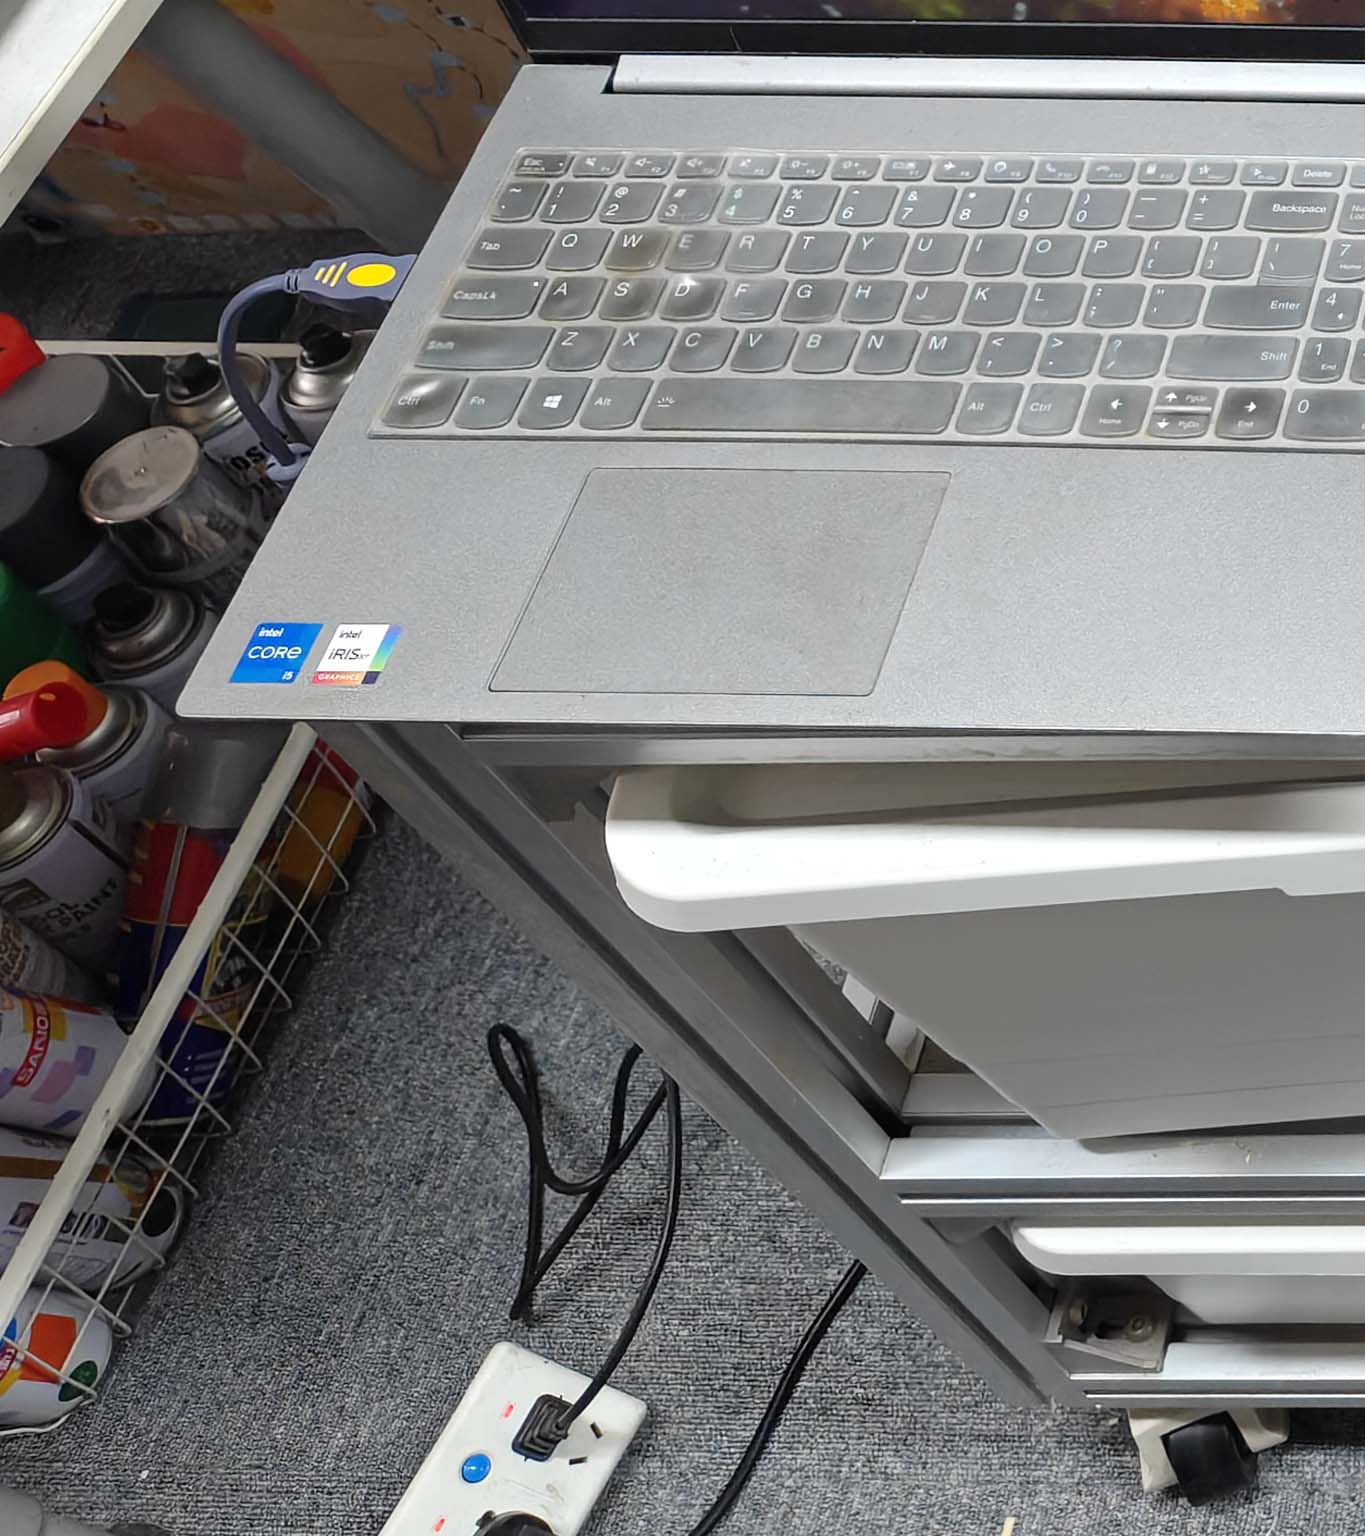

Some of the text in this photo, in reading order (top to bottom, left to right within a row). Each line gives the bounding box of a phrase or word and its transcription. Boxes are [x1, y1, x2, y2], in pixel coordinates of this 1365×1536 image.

[606, 204, 620, 215] 2
[783, 206, 796, 218] 5
[842, 206, 854, 219] 6
[902, 207, 913, 220] 7
[959, 208, 972, 220] 8
[1017, 209, 1029, 221] 9
[1272, 203, 1327, 214] Backspace
[1076, 210, 1088, 222] 0
[562, 234, 578, 248] Q
[623, 234, 643, 248] W
[679, 234, 695, 248] E
[739, 235, 755, 249] R
[803, 235, 815, 250] T
[861, 236, 875, 251] Y
[918, 238, 934, 252] U
[1036, 239, 1051, 253] O
[1094, 240, 1108, 253] P
[1340, 244, 1351, 257] 7
[553, 282, 568, 296] A
[614, 282, 630, 297] S
[674, 283, 690, 297] D
[734, 284, 749, 297] F
[797, 284, 813, 298] G
[855, 285, 872, 298] H
[915, 286, 929, 300] J
[975, 288, 989, 301] K
[1035, 287, 1045, 302] L
[1270, 300, 1300, 311] Enter
[1326, 293, 1337, 307] 4
[560, 331, 579, 346] Z
[622, 331, 640, 346] X
[685, 332, 701, 347] C
[749, 333, 763, 348] V
[806, 334, 822, 349] B
[867, 335, 885, 350] N
[928, 336, 948, 350] M
[1260, 351, 1288, 361] Shift
[1314, 343, 1323, 356] 1
[1297, 399, 1310, 414] 0
[258, 627, 284, 638] intel
[339, 629, 362, 639] intel
[282, 671, 293, 681] i5
[317, 673, 361, 682] GRAPHICS
